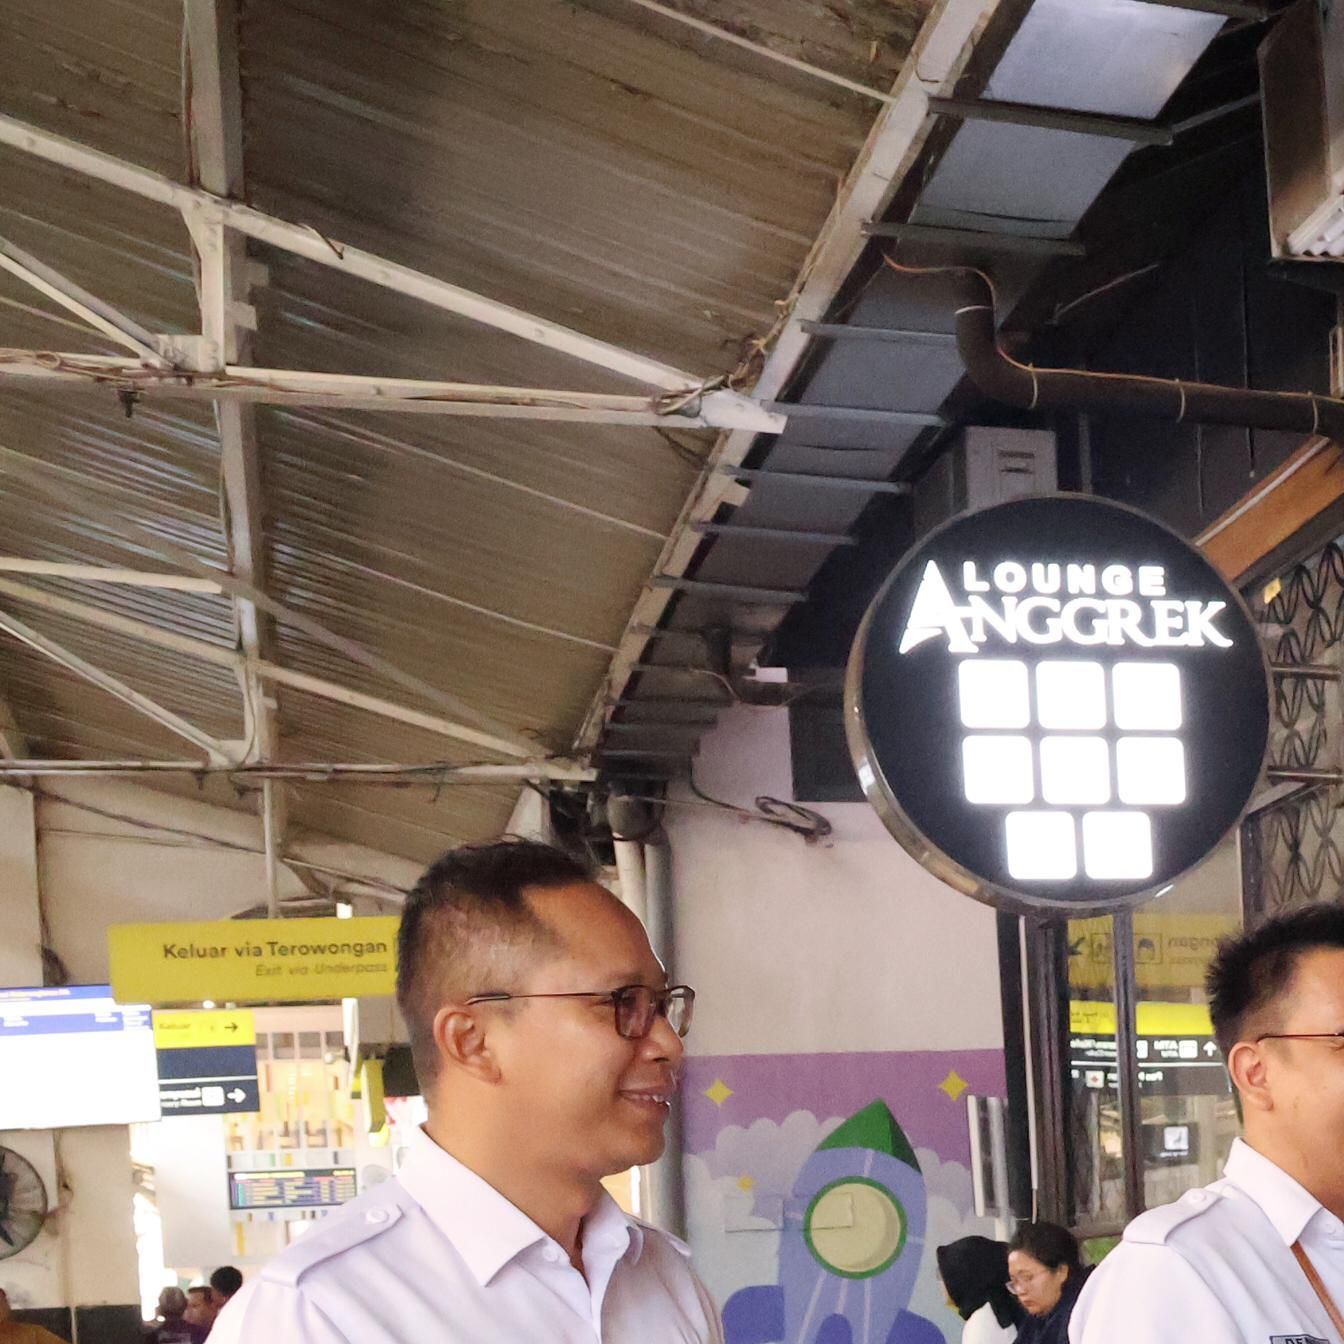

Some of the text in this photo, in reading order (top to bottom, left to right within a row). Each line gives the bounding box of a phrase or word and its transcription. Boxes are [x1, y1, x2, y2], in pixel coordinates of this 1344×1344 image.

[963, 560, 1166, 596] LOUNGE
[899, 559, 1233, 653] ANGGREK
[163, 941, 387, 959] Keluar via Terowongan
[255, 963, 388, 976] Exit via Underpass
